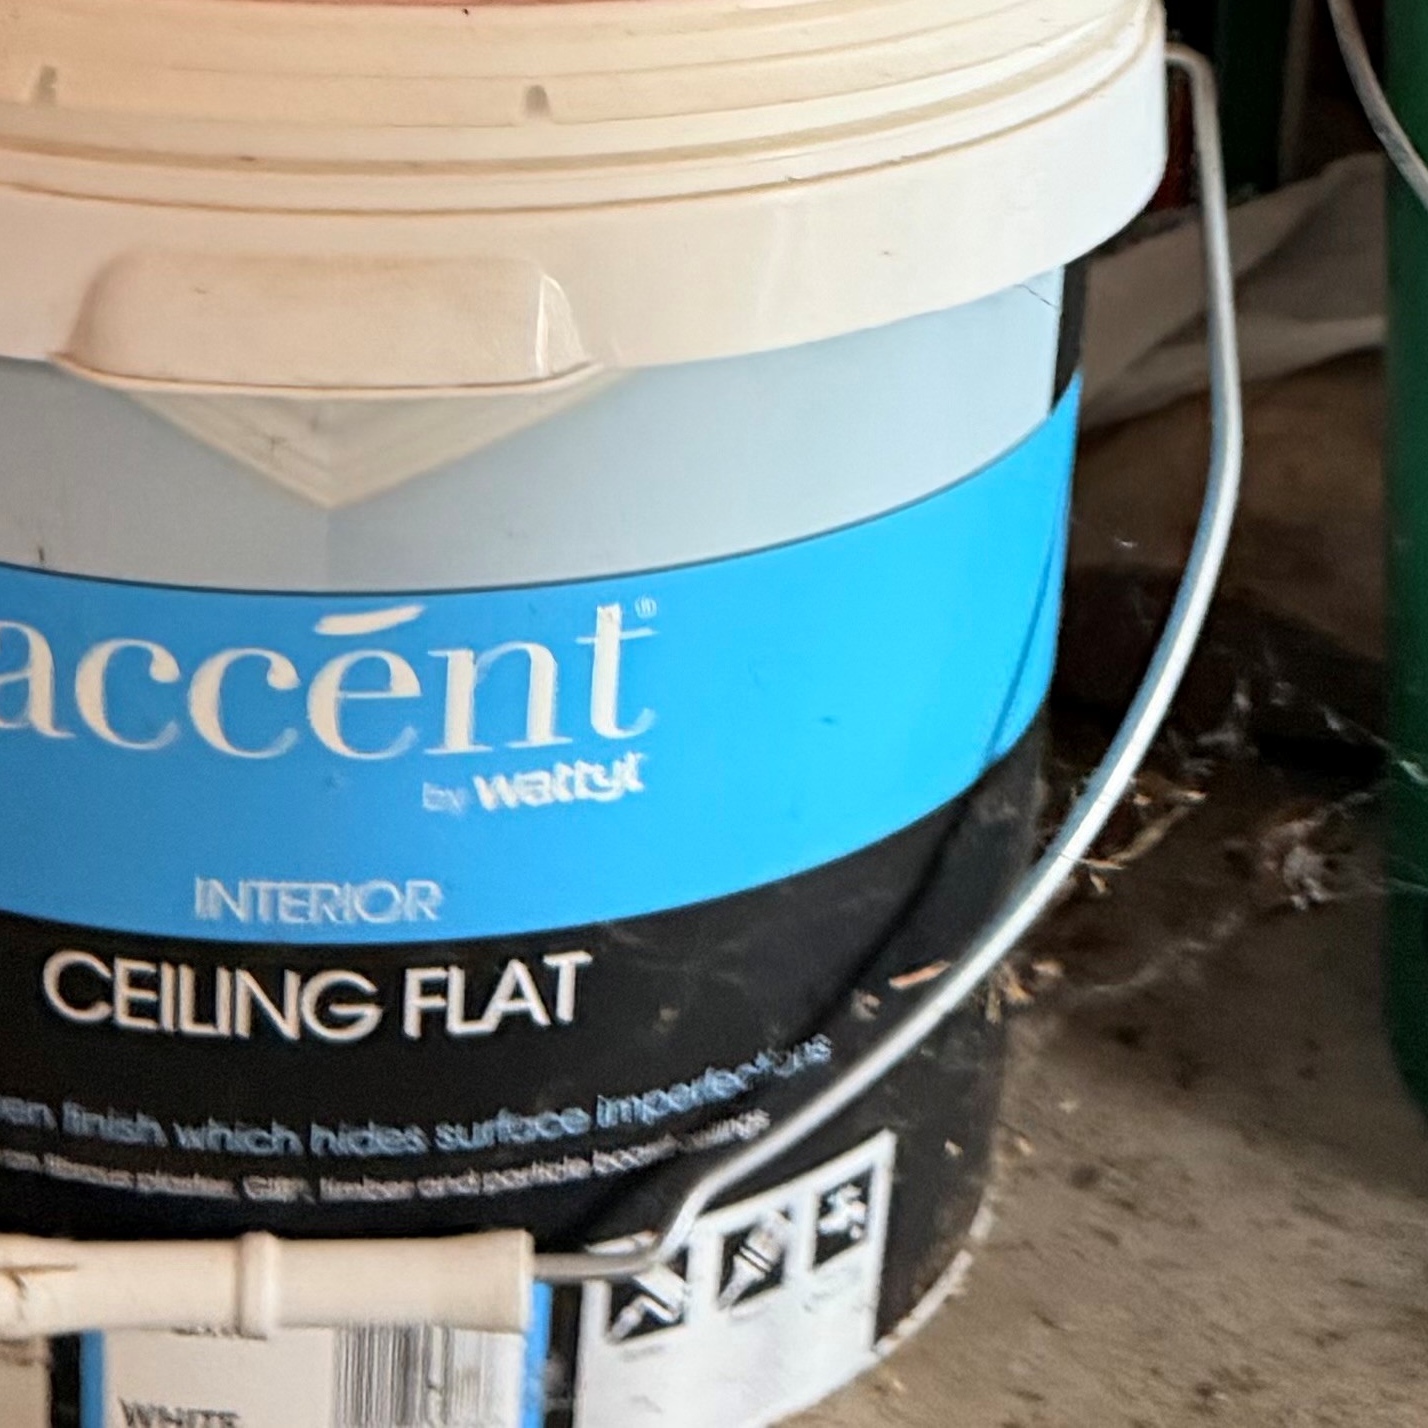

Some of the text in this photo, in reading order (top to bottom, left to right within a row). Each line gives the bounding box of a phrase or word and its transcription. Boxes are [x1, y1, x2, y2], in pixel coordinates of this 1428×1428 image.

[421, 778, 471, 817] by
[194, 874, 445, 925] INTERIOR
[42, 948, 595, 1043] CEILING FLAT
[60, 1099, 168, 1147] finish
[171, 1115, 305, 1157] which
[309, 1120, 428, 1157] hides
[433, 1106, 592, 1154] surface
